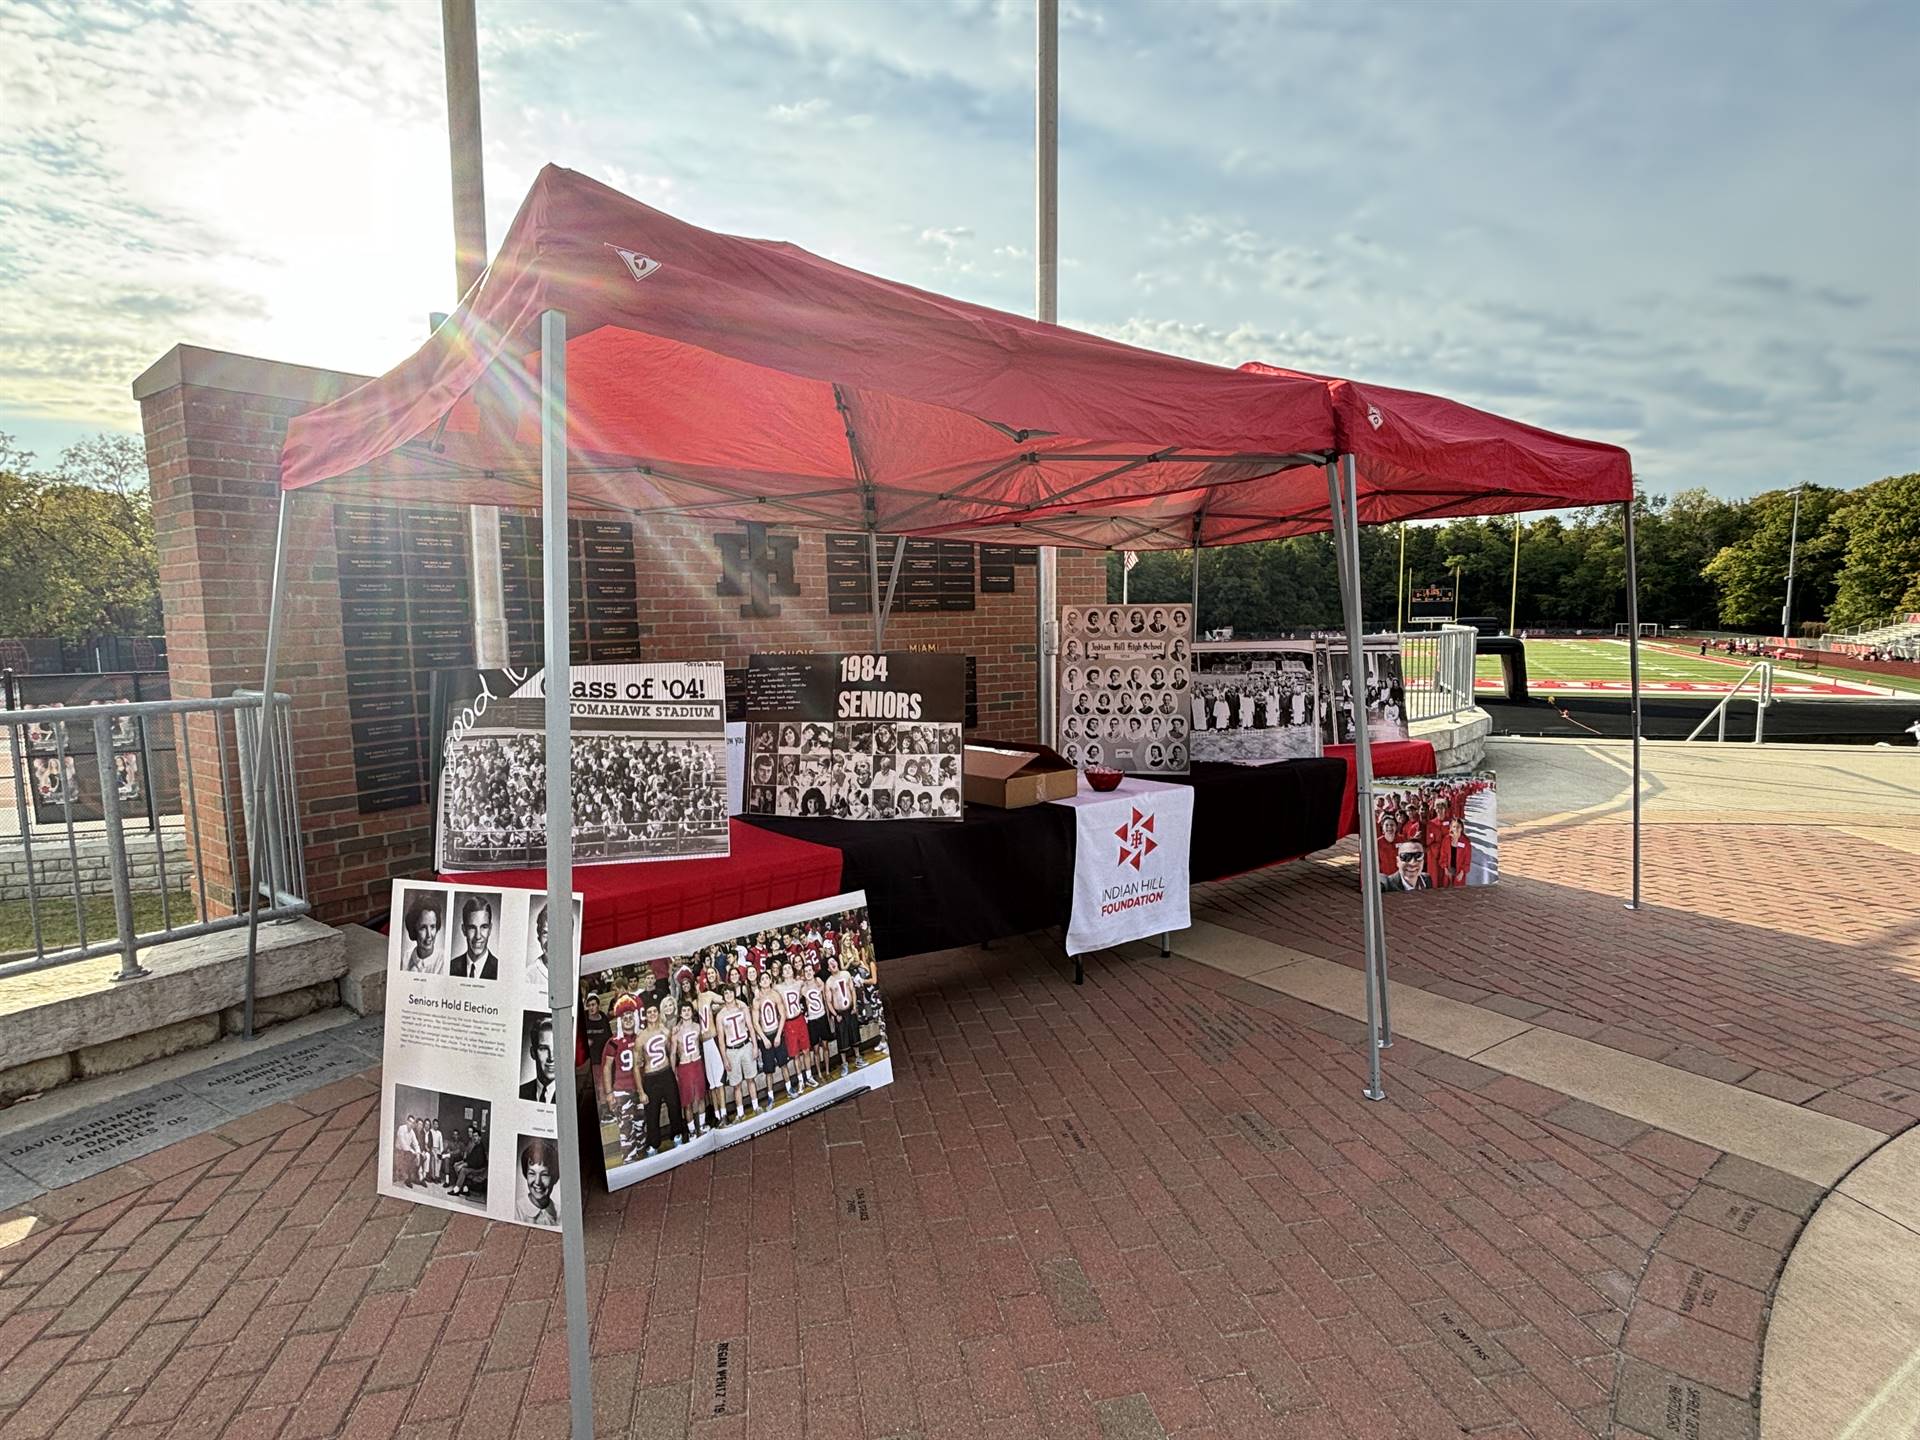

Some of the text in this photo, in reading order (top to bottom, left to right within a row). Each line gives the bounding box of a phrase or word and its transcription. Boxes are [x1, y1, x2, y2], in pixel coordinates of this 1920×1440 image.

[909, 643, 940, 653] MIAMI
[840, 655, 889, 682] 1984
[625, 678, 654, 699] of
[570, 703, 715, 718] TOMAHAWK STADIUM
[838, 689, 922, 720] SENIORS
[1103, 877, 1165, 901] INDIAN HILL
[1101, 891, 1164, 917] FOUNDATION
[408, 993, 499, 1015] Seniors Hold Election
[61, 1110, 158, 1147] SAMANTHA
[10, 1135, 64, 1157] DAVID
[717, 1343, 729, 1368] REGAN
[715, 1369, 727, 1399] WENTZ
